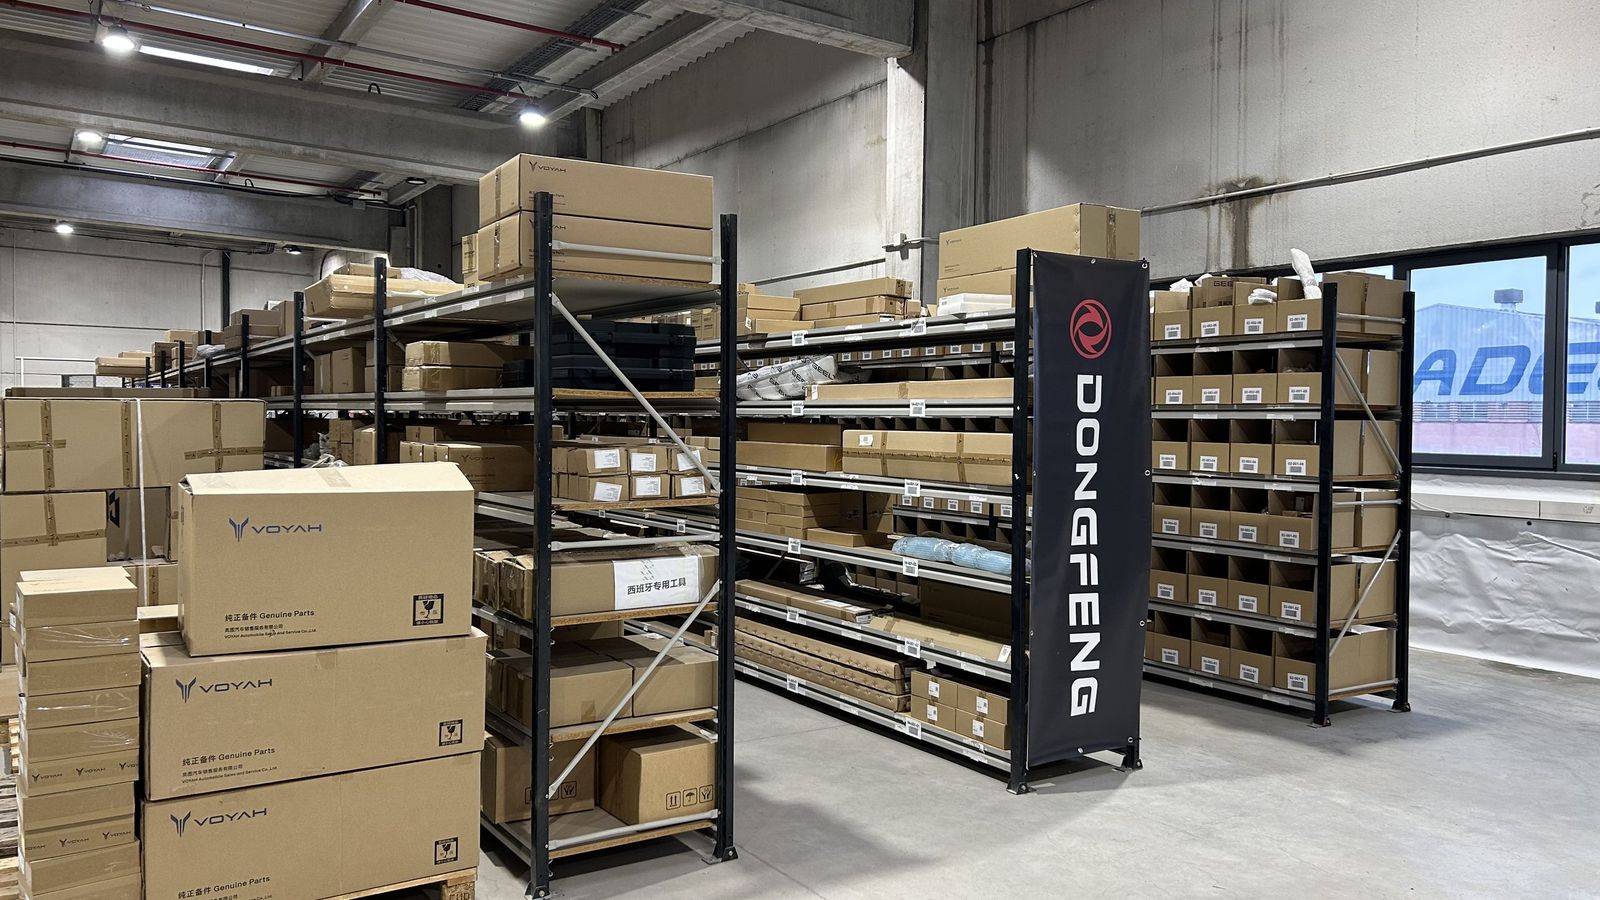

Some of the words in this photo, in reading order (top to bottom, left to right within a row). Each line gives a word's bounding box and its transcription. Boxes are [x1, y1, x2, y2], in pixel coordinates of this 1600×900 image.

[538, 165, 567, 173] VOYAH
[1414, 341, 1600, 396] ADE
[251, 523, 322, 534] VOYAH
[1068, 373, 1103, 717] DONGFENG
[627, 577, 686, 595] 西班牙专用工具
[225, 613, 258, 622] 纯正备件
[200, 679, 273, 693] VOYAH
[182, 755, 216, 767] 纯正备件
[218, 751, 252, 761] Genuine
[254, 747, 276, 756] Parts
[194, 808, 268, 826] VOYAH
[178, 887, 212, 899] 纯正备件
[213, 881, 247, 892] Genuine
[249, 876, 271, 885] Parts
